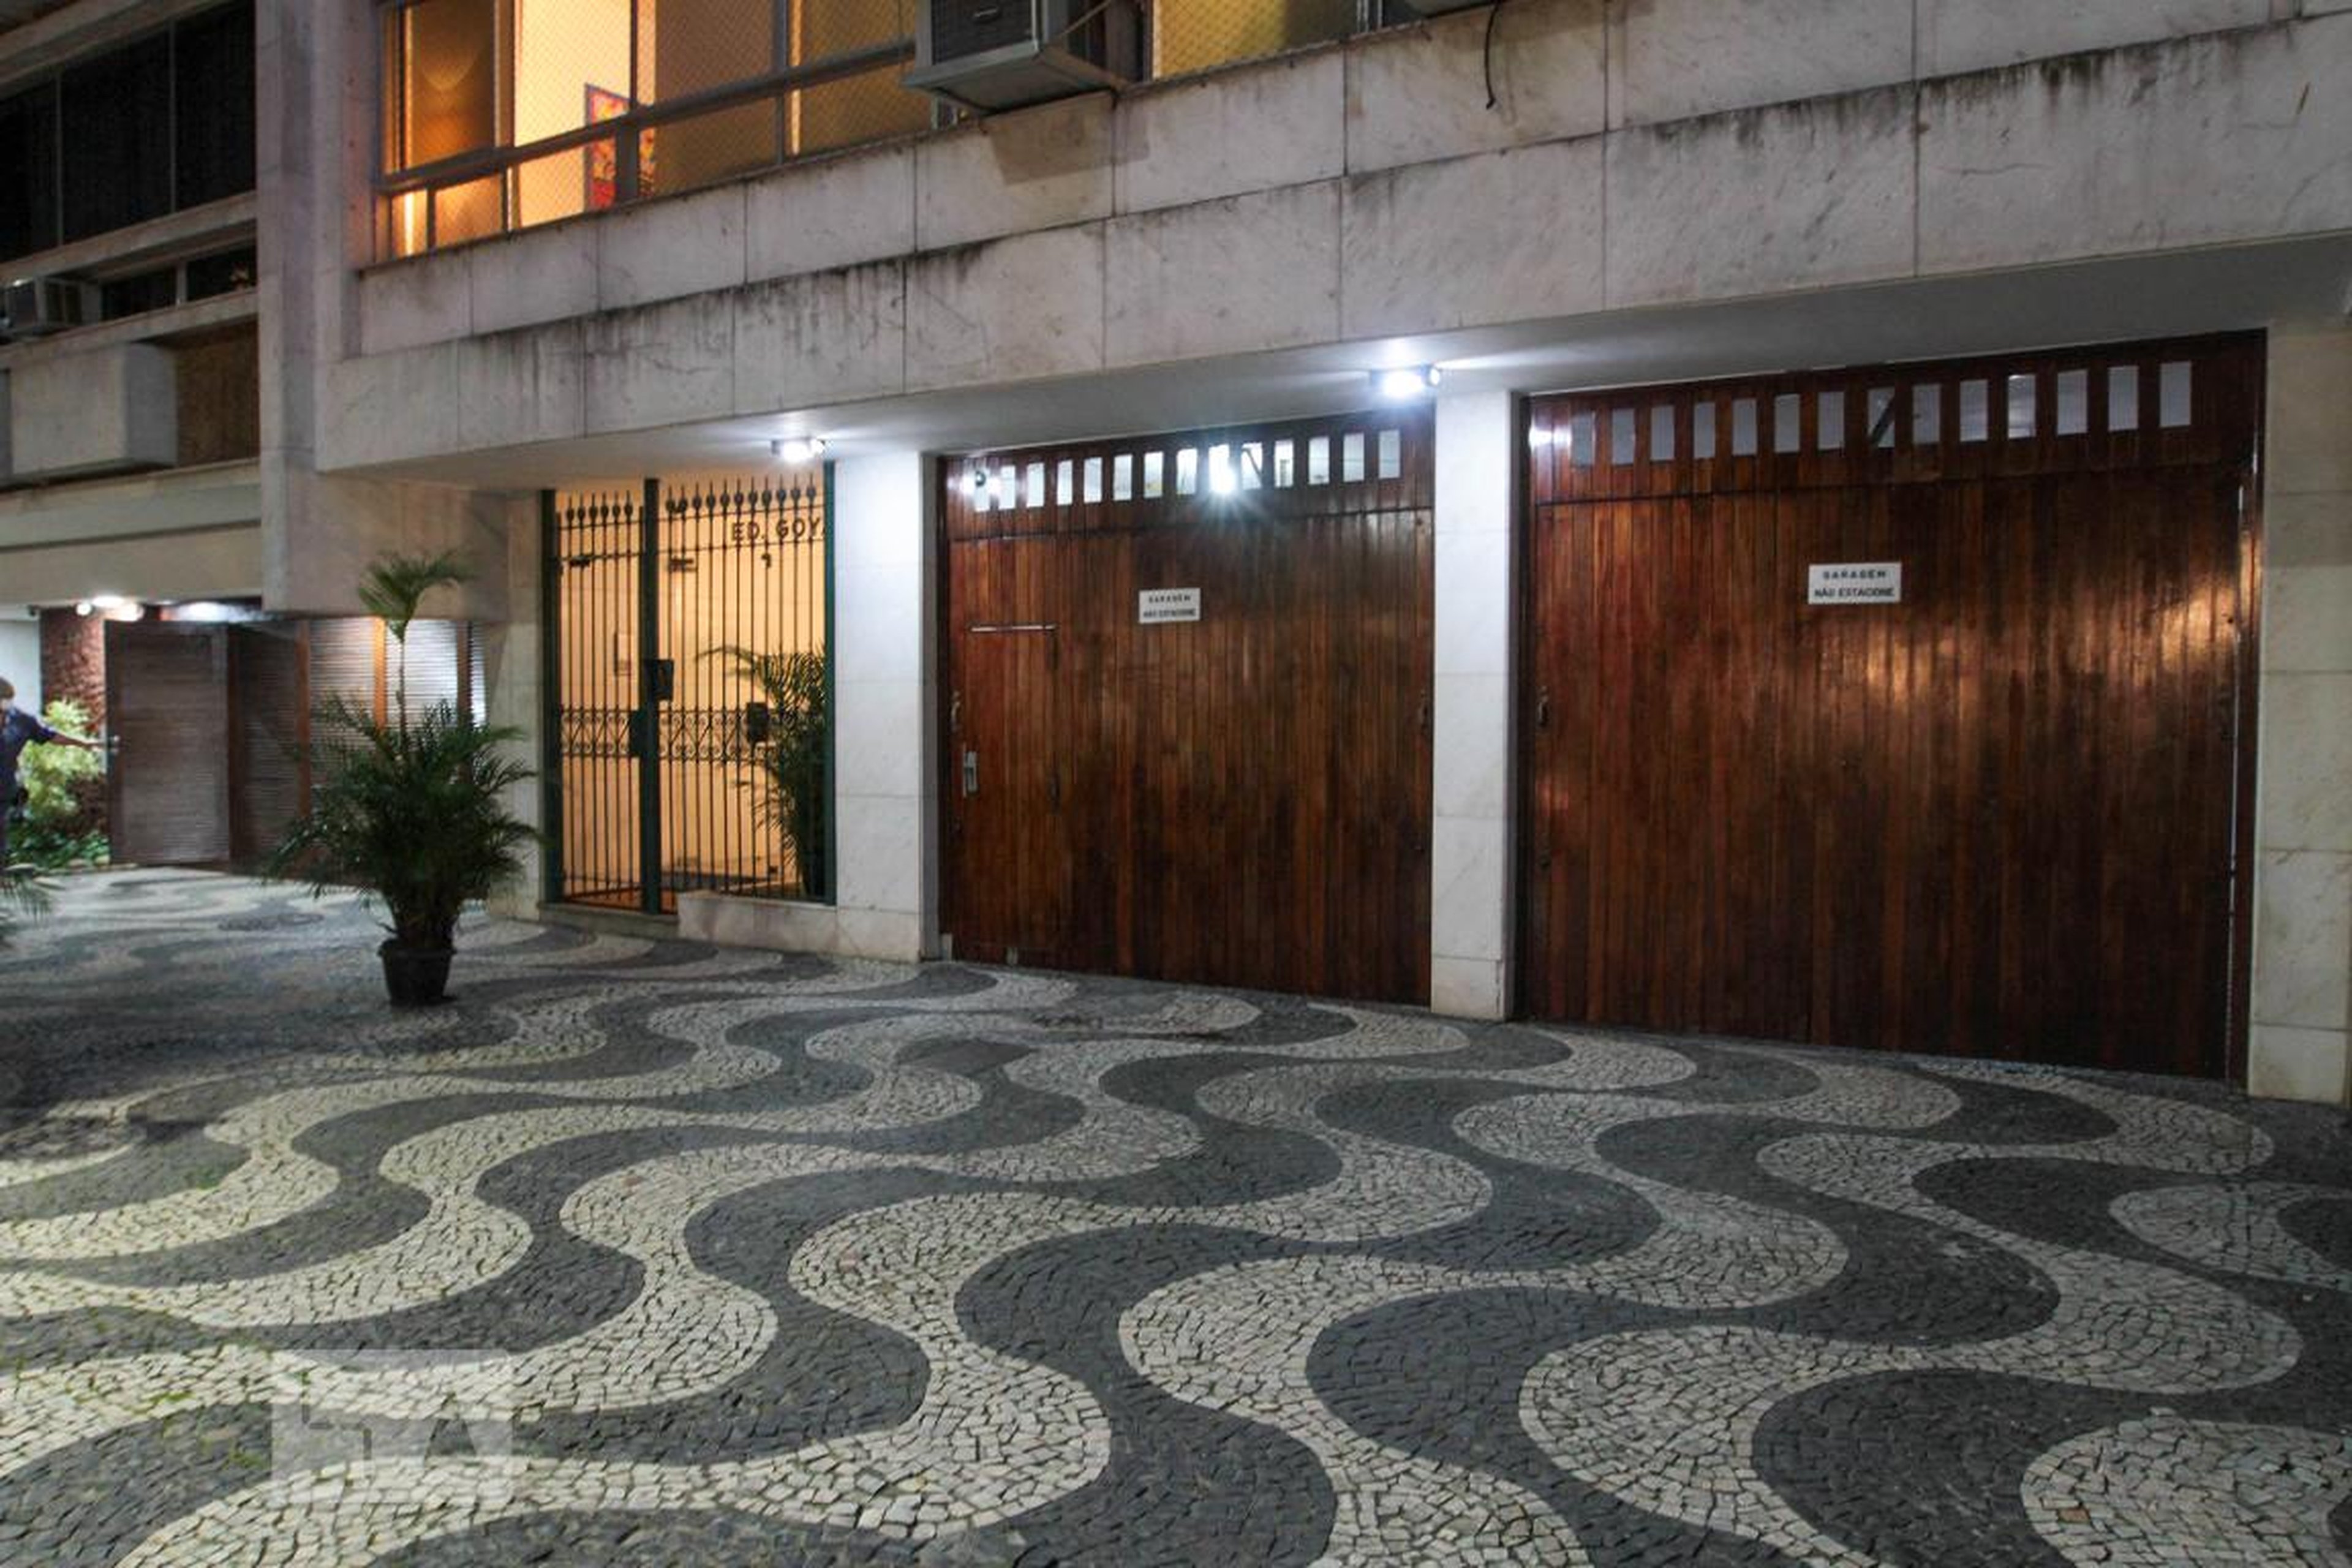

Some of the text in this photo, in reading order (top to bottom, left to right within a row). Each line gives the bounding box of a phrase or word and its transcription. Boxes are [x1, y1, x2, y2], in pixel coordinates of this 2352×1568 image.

[731, 517, 825, 541] ED. GOY
[1822, 569, 1886, 579] GARAGEM
